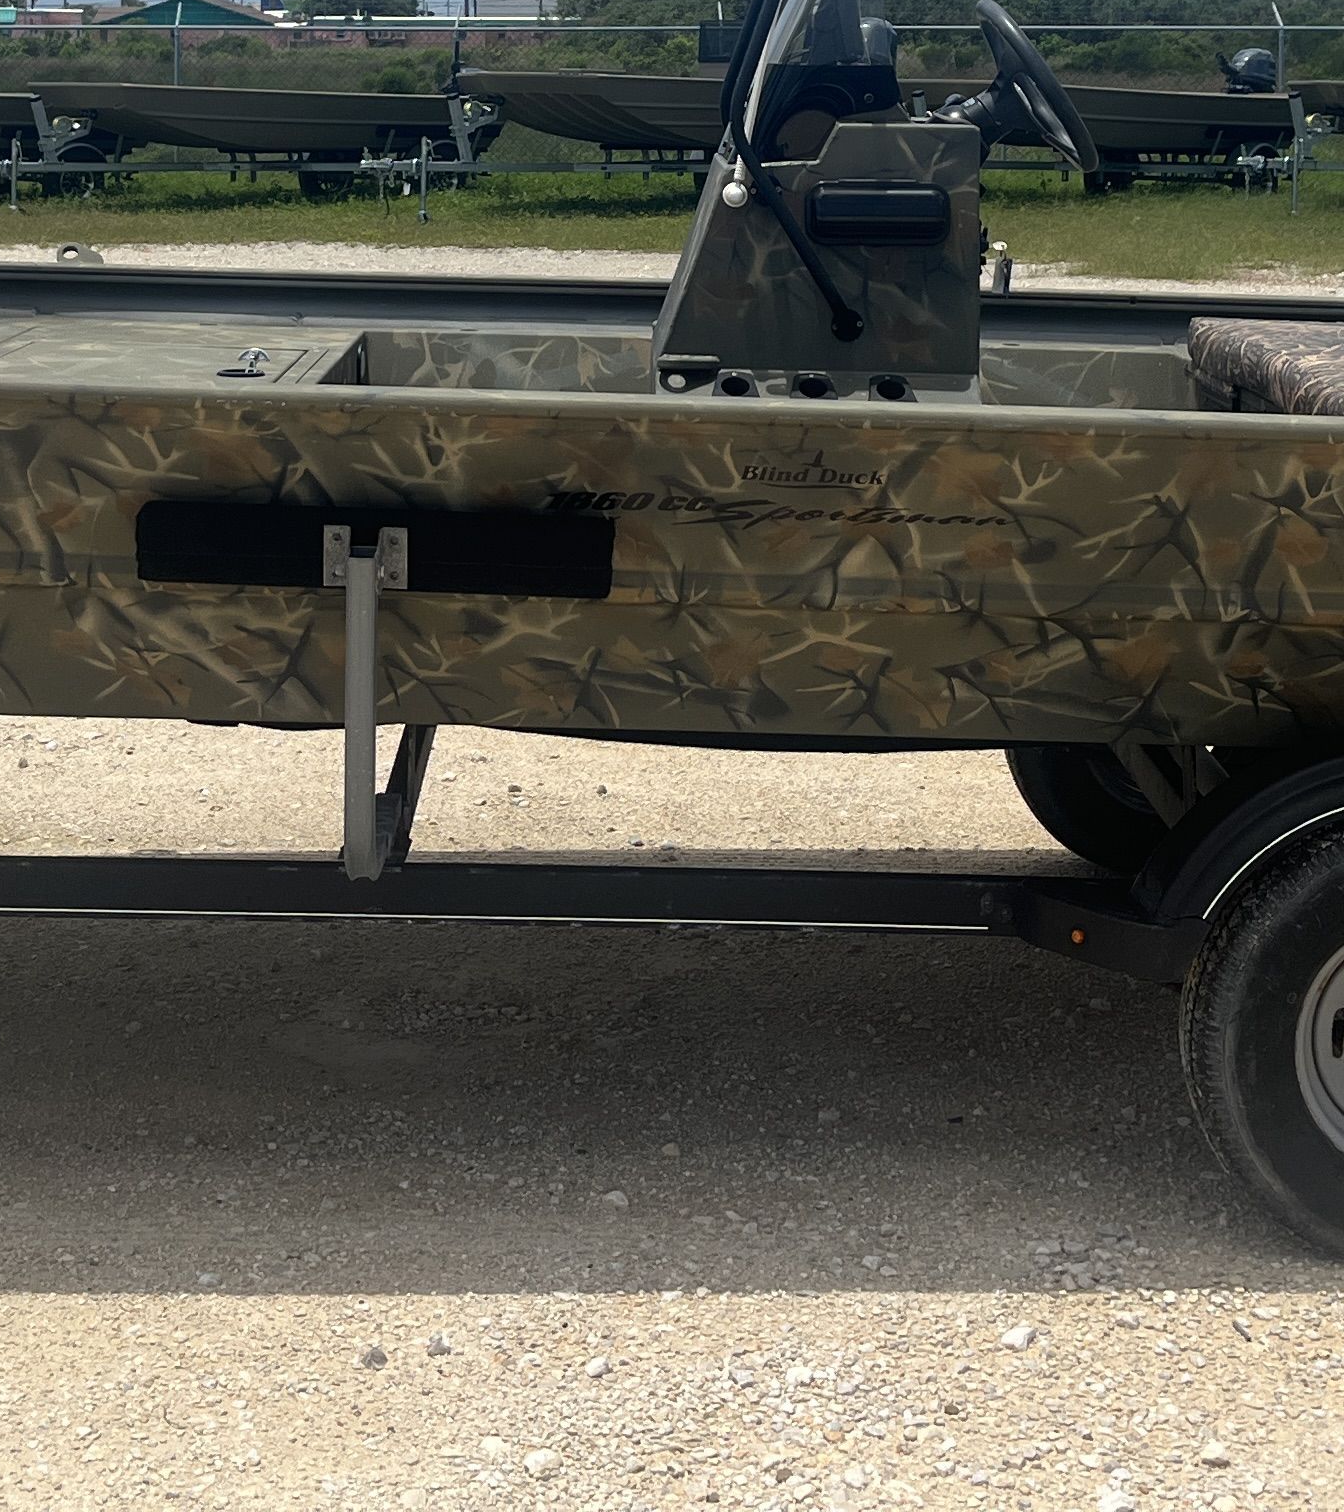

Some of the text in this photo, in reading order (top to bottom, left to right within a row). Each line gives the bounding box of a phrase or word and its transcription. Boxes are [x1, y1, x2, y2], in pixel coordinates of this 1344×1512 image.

[741, 465, 885, 485] Blind Duck
[545, 491, 655, 511] 1860
[671, 498, 1017, 530] Sportsman
